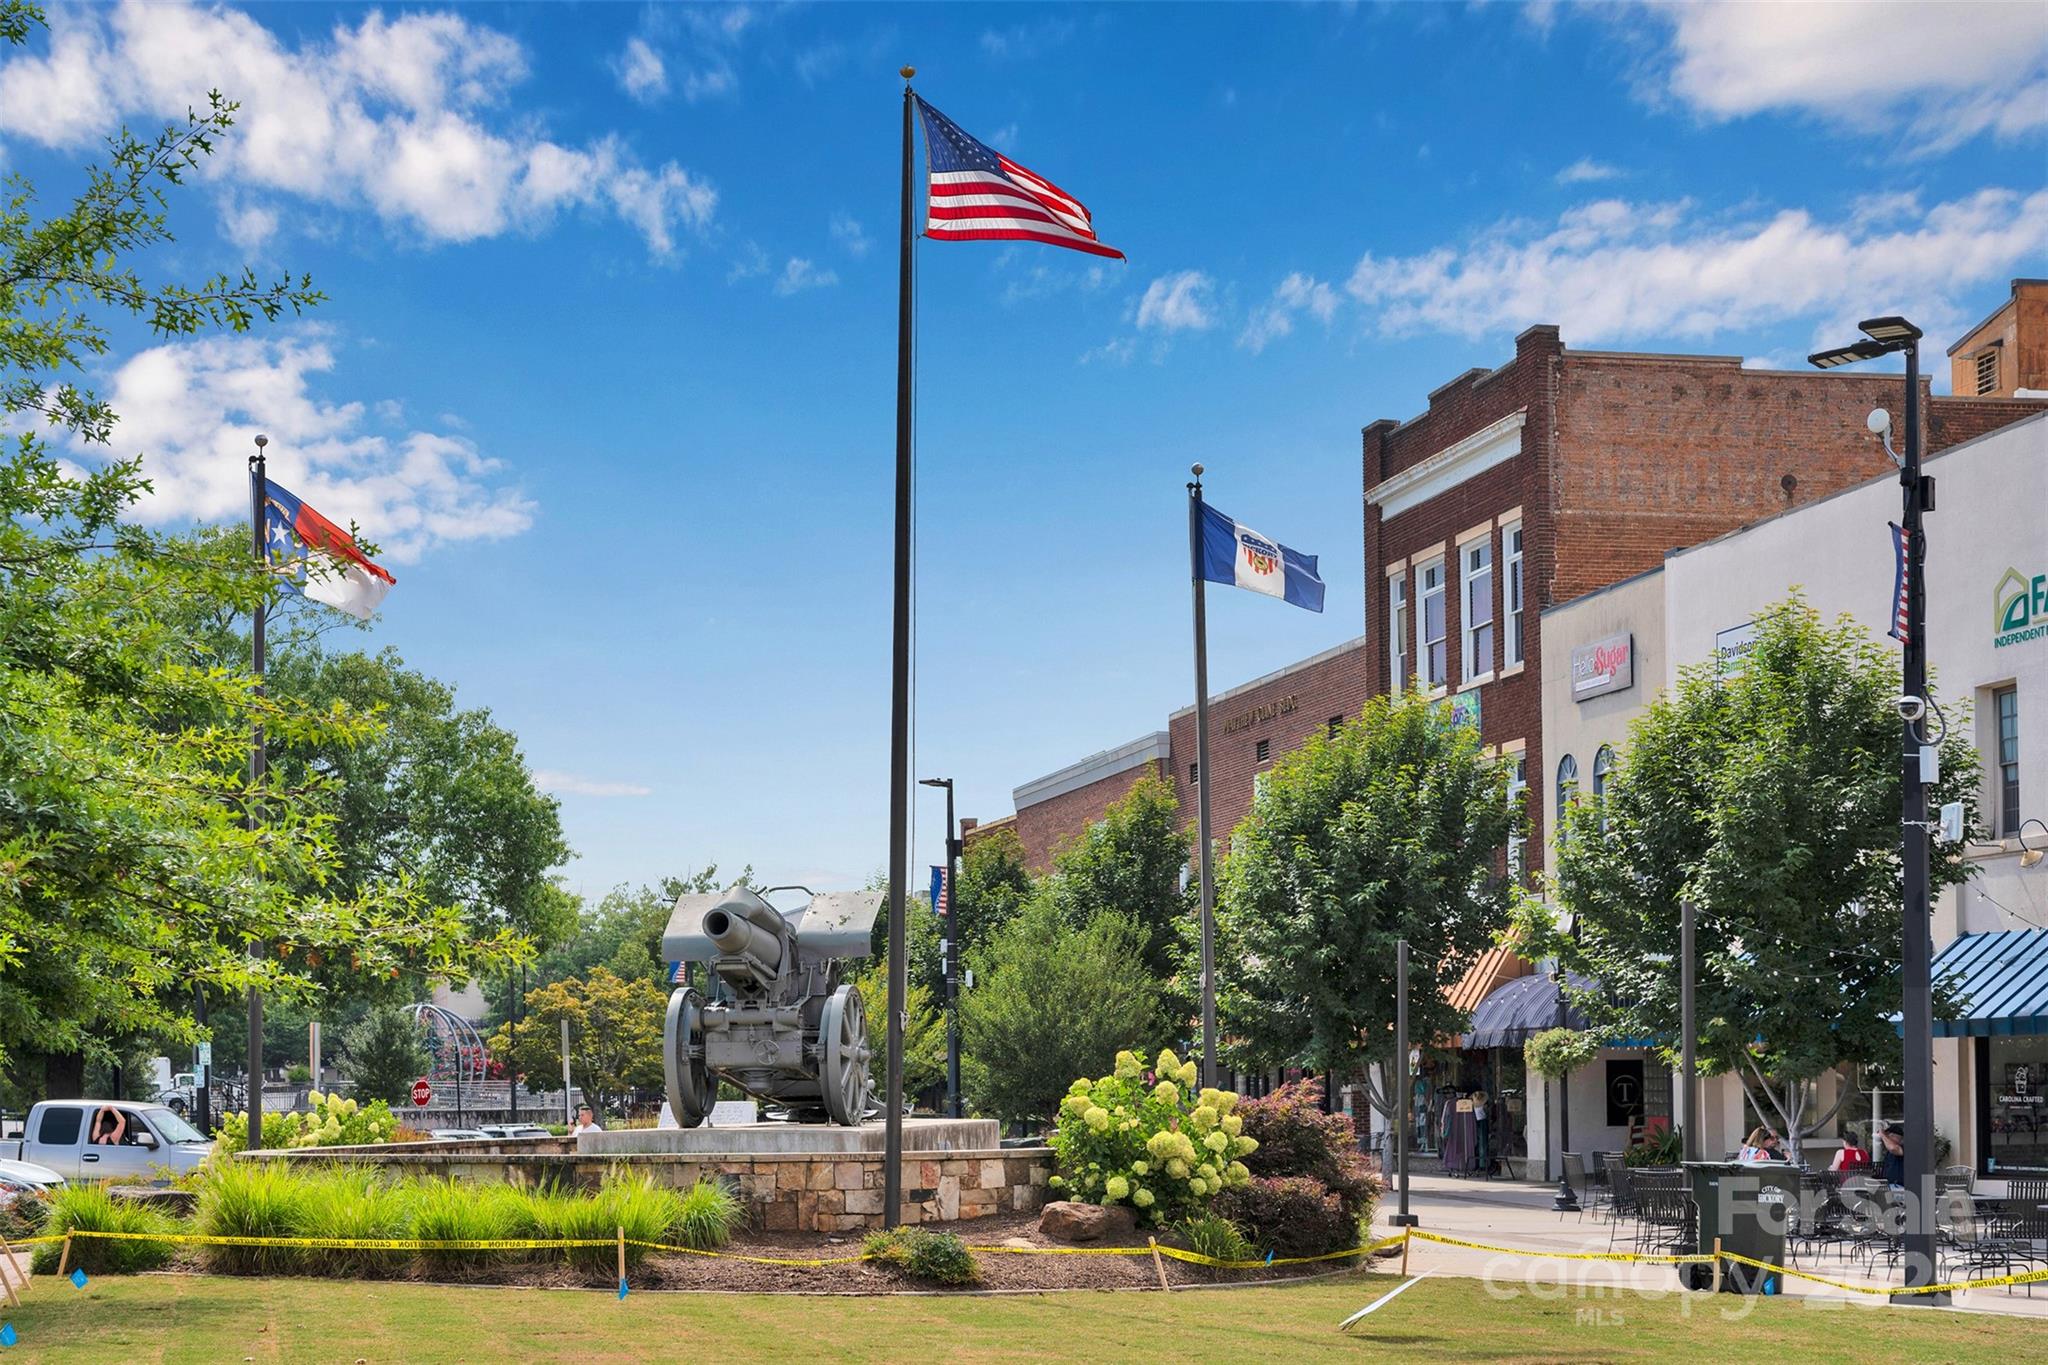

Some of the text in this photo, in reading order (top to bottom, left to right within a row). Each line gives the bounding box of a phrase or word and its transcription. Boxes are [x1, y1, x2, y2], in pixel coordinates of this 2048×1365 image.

[1994, 626, 2045, 648] INDEPENDENT
[1594, 645, 1628, 676] Sugar
[412, 1088, 431, 1100] STOP
[1999, 1095, 2022, 1103] CAROLINA
[1761, 1185, 1774, 1194] CITY
